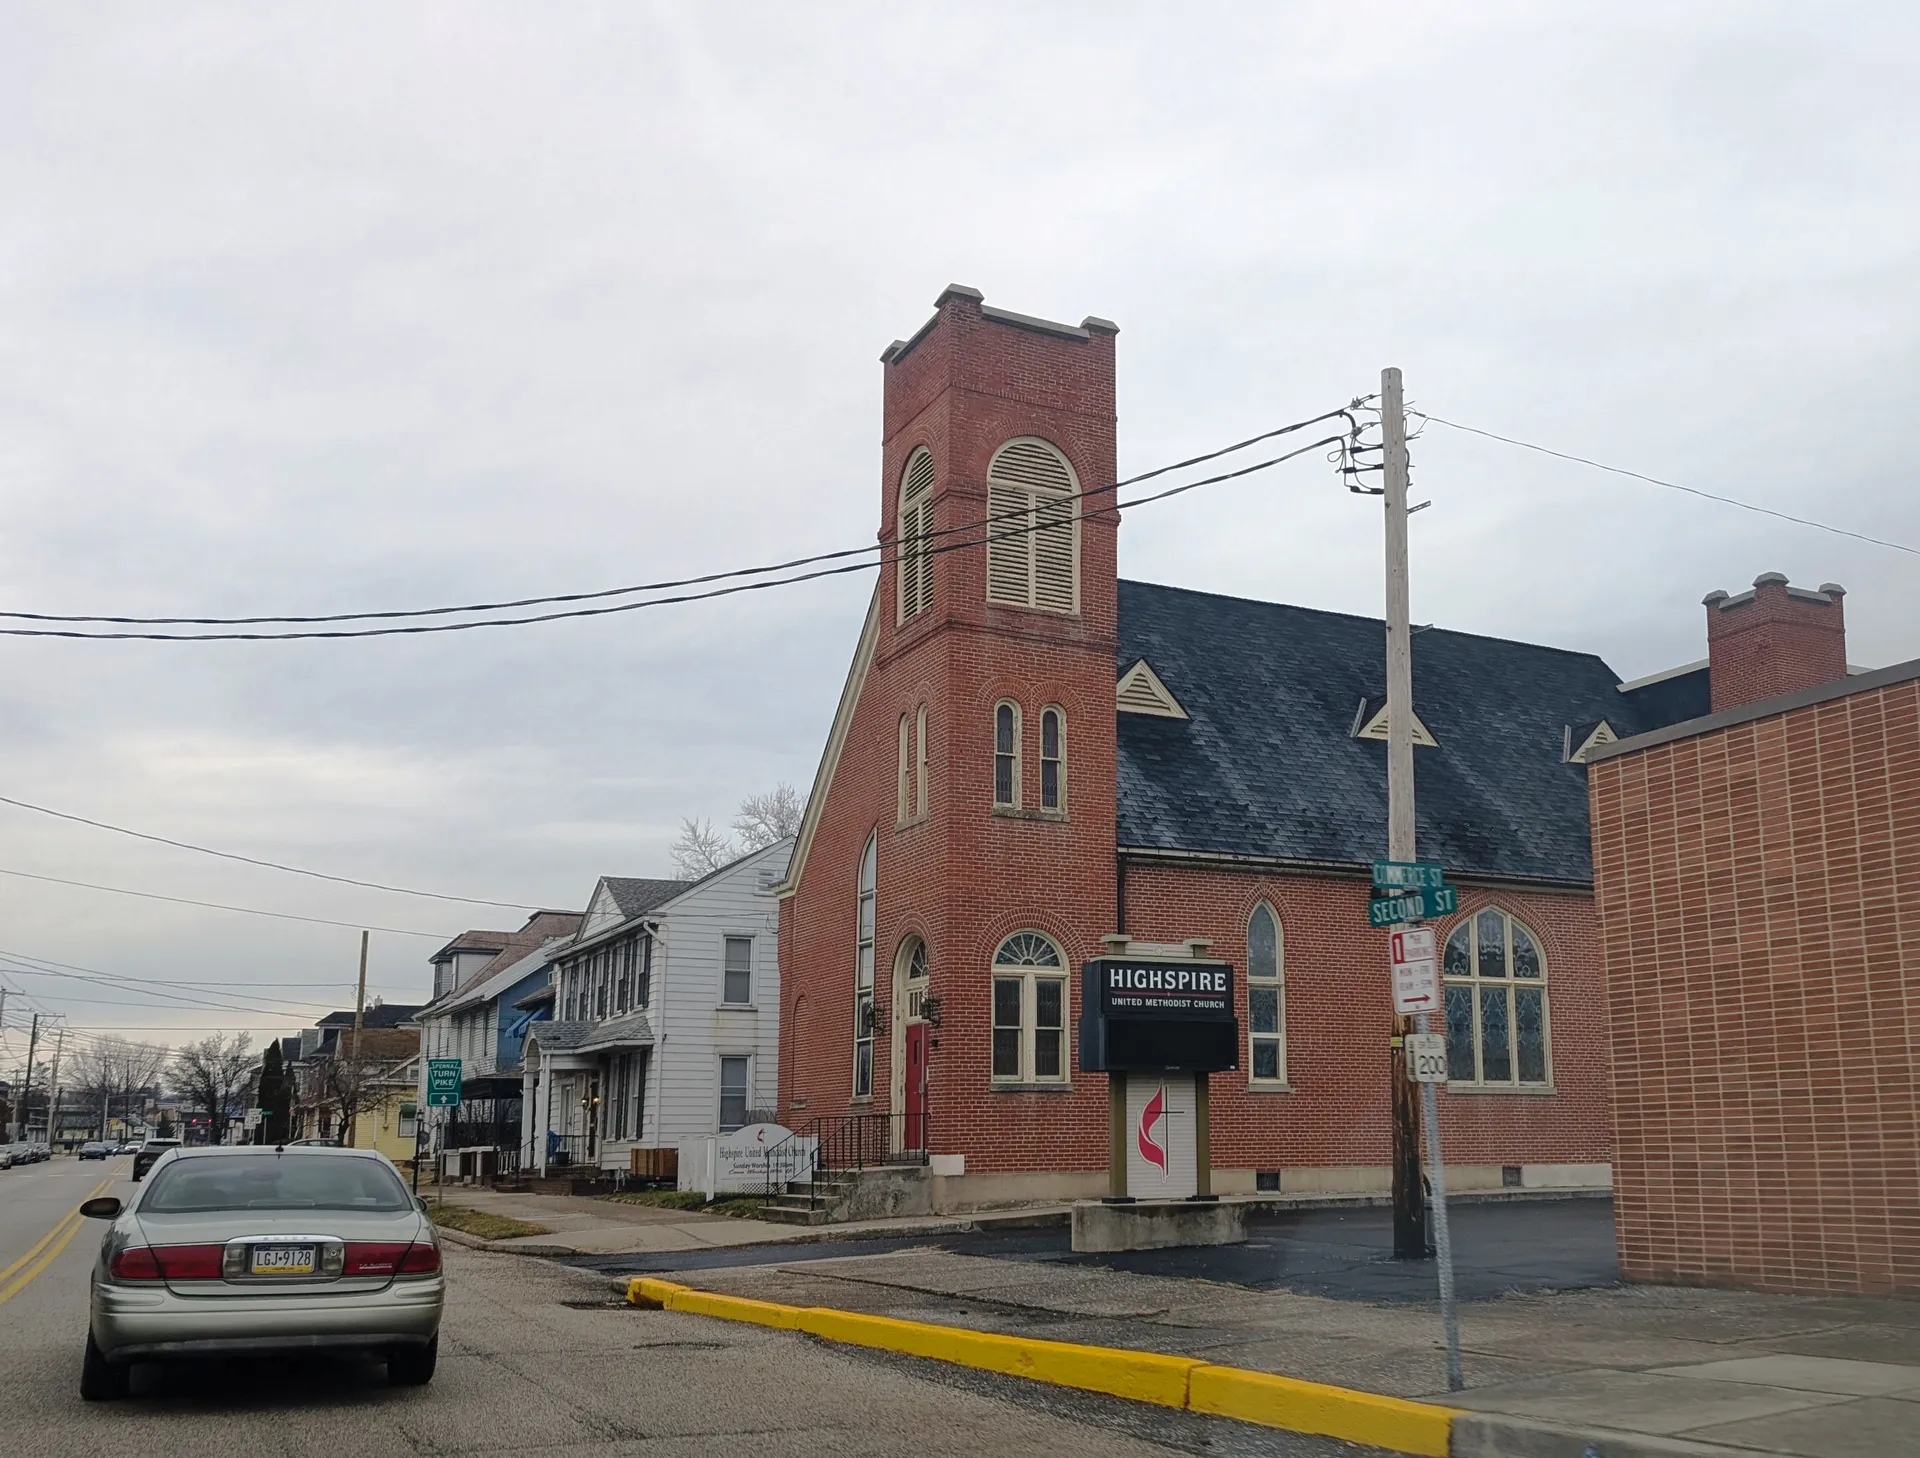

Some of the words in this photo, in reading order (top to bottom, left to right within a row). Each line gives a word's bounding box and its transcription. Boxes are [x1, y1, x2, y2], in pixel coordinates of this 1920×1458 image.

[1373, 895, 1425, 923] SECOND
[1435, 889, 1452, 912] ST
[1109, 968, 1227, 992] HIGHSPIRE
[1111, 997, 1143, 1006] UNITED
[1145, 998, 1192, 1008] METHODIST
[1193, 1000, 1225, 1009] CHURCH
[1419, 1054, 1446, 1075] 200
[719, 1146, 743, 1161] Highspire
[744, 1146, 762, 1158] United
